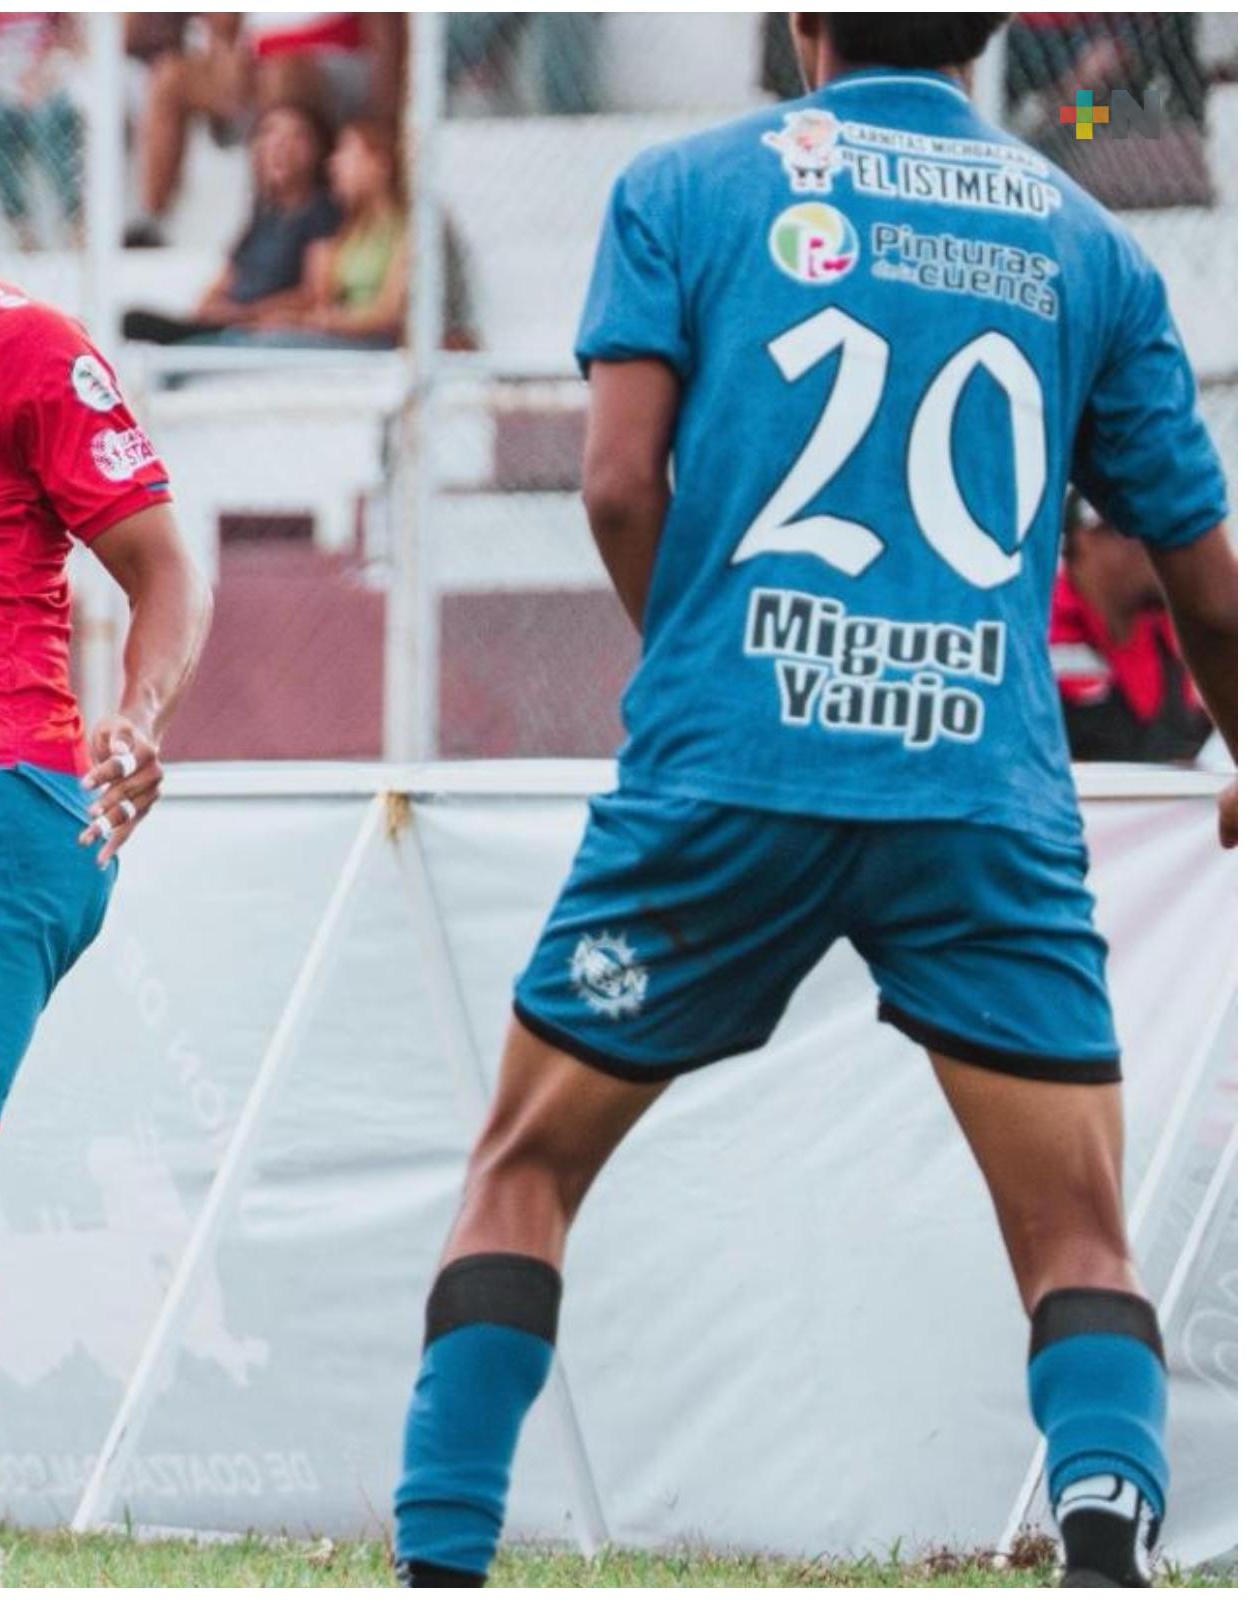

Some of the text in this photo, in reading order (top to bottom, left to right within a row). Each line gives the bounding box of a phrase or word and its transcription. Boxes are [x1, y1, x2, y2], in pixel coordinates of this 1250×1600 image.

[874, 225, 1048, 281] Pinturas
[917, 263, 1057, 316] cuenca
[730, 304, 1048, 590] 20
[747, 591, 1003, 680] Miguel
[778, 662, 981, 745] Yanjo
